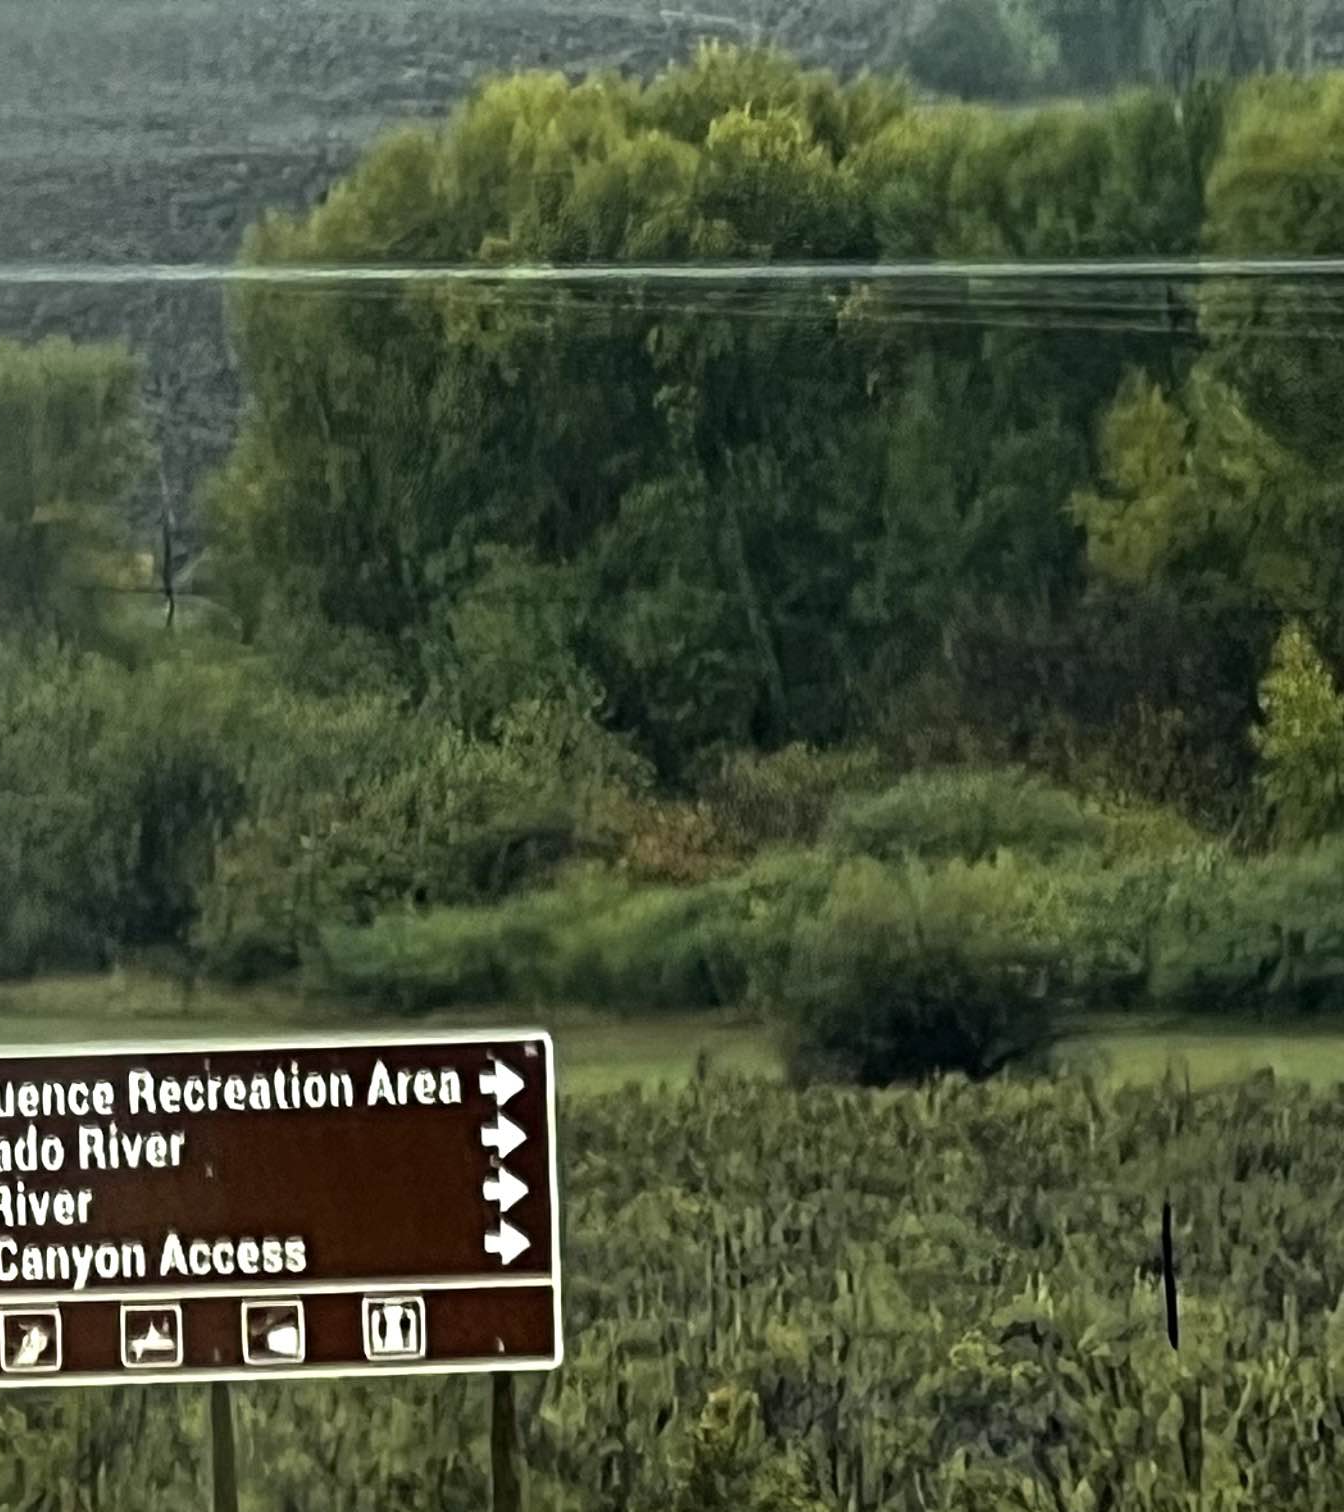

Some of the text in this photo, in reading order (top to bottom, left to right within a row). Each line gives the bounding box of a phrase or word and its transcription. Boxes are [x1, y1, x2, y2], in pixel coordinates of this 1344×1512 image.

[127, 1066, 355, 1115] Recreation
[367, 1058, 462, 1109] Area
[78, 1122, 185, 1170] River
[159, 1231, 307, 1278] Access
